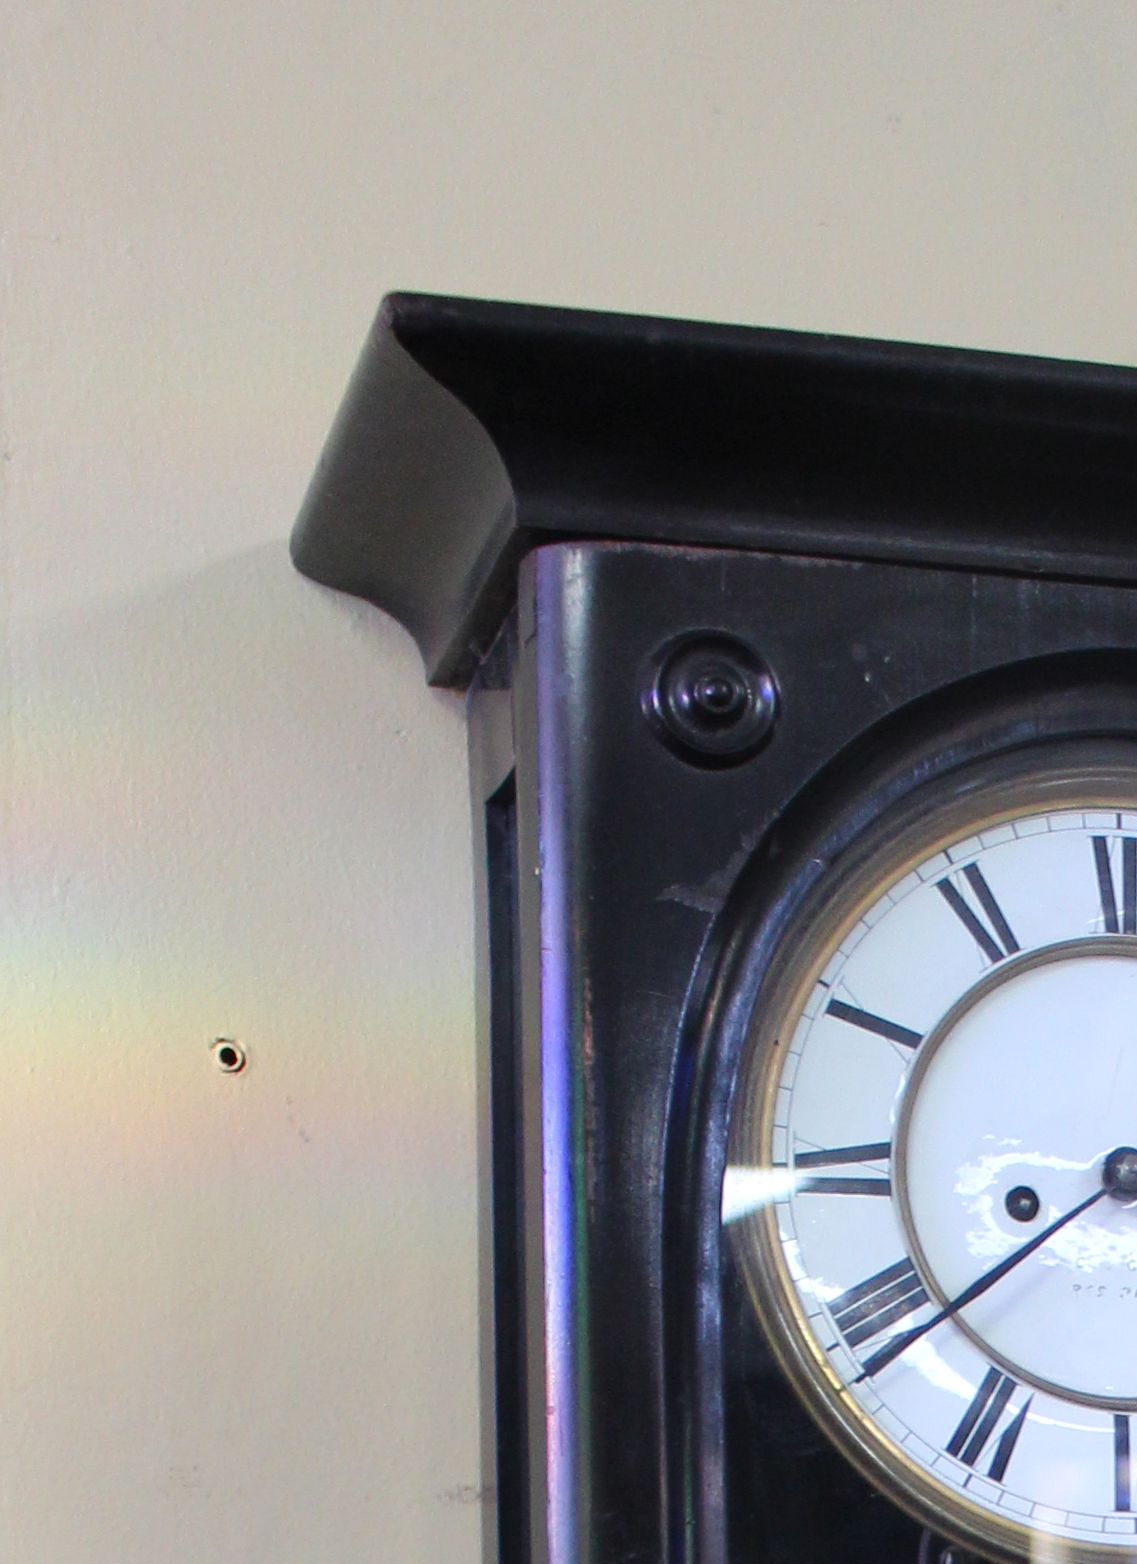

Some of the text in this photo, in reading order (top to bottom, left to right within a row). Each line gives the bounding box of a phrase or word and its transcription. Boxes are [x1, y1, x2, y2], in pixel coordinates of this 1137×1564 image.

[931, 859, 1027, 972] XI
[822, 976, 929, 1064] X
[793, 1131, 893, 1198] IX
[938, 1362, 1036, 1488] VII
